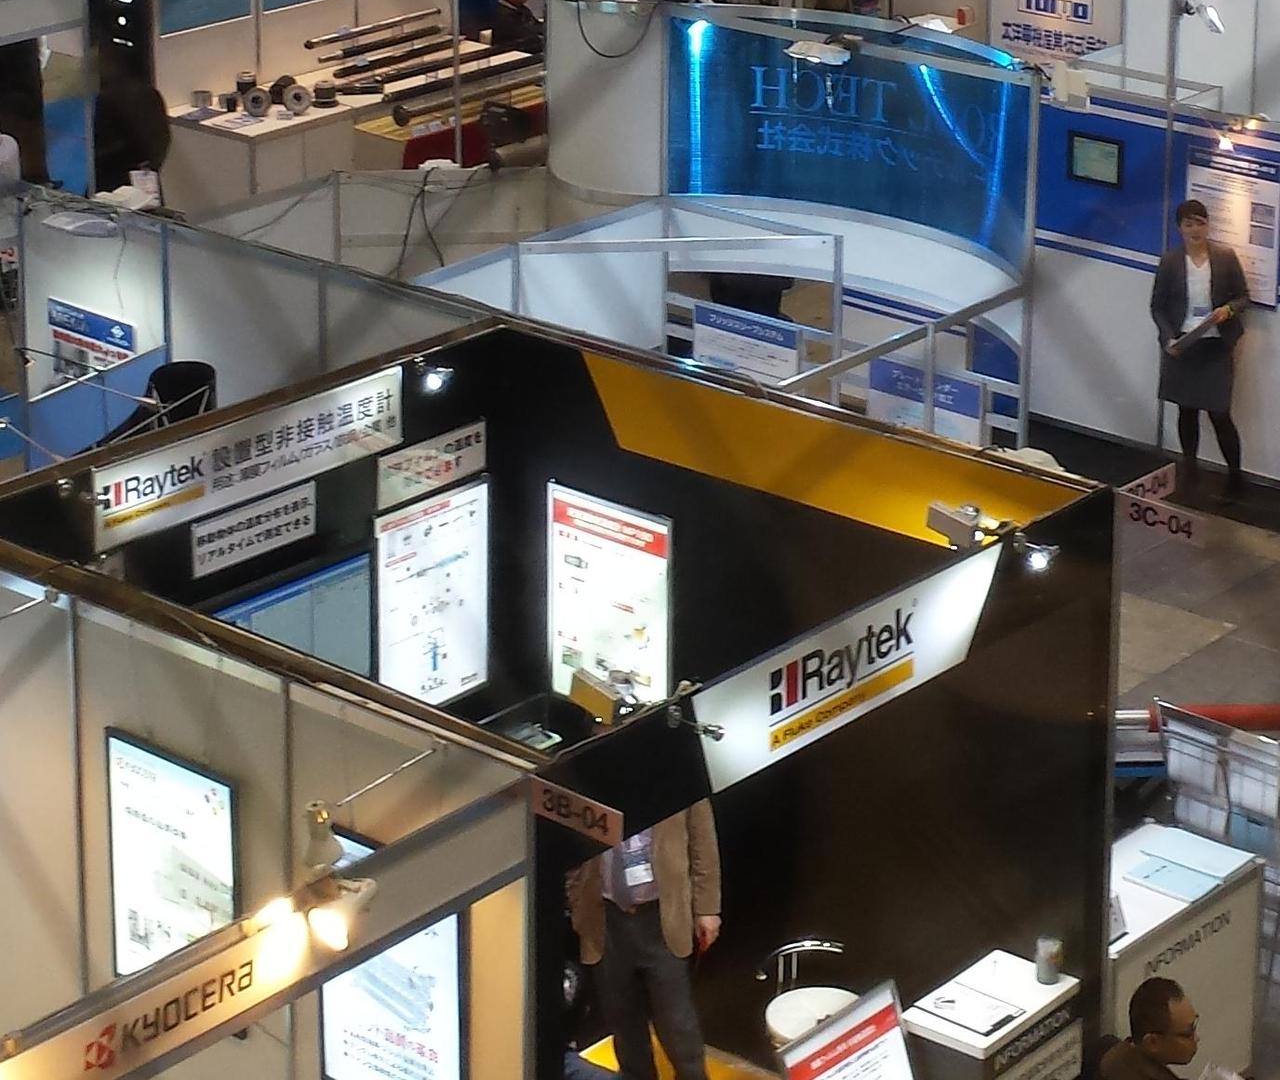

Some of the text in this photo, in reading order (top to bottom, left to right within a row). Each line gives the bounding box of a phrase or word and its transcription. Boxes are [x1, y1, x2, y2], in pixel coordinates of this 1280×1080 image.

[124, 455, 206, 504] Raytek
[1128, 501, 1193, 540] 3C-04
[800, 607, 916, 702] Raytek
[543, 787, 610, 836] 3B-04
[121, 958, 255, 1052] KYOCERA
